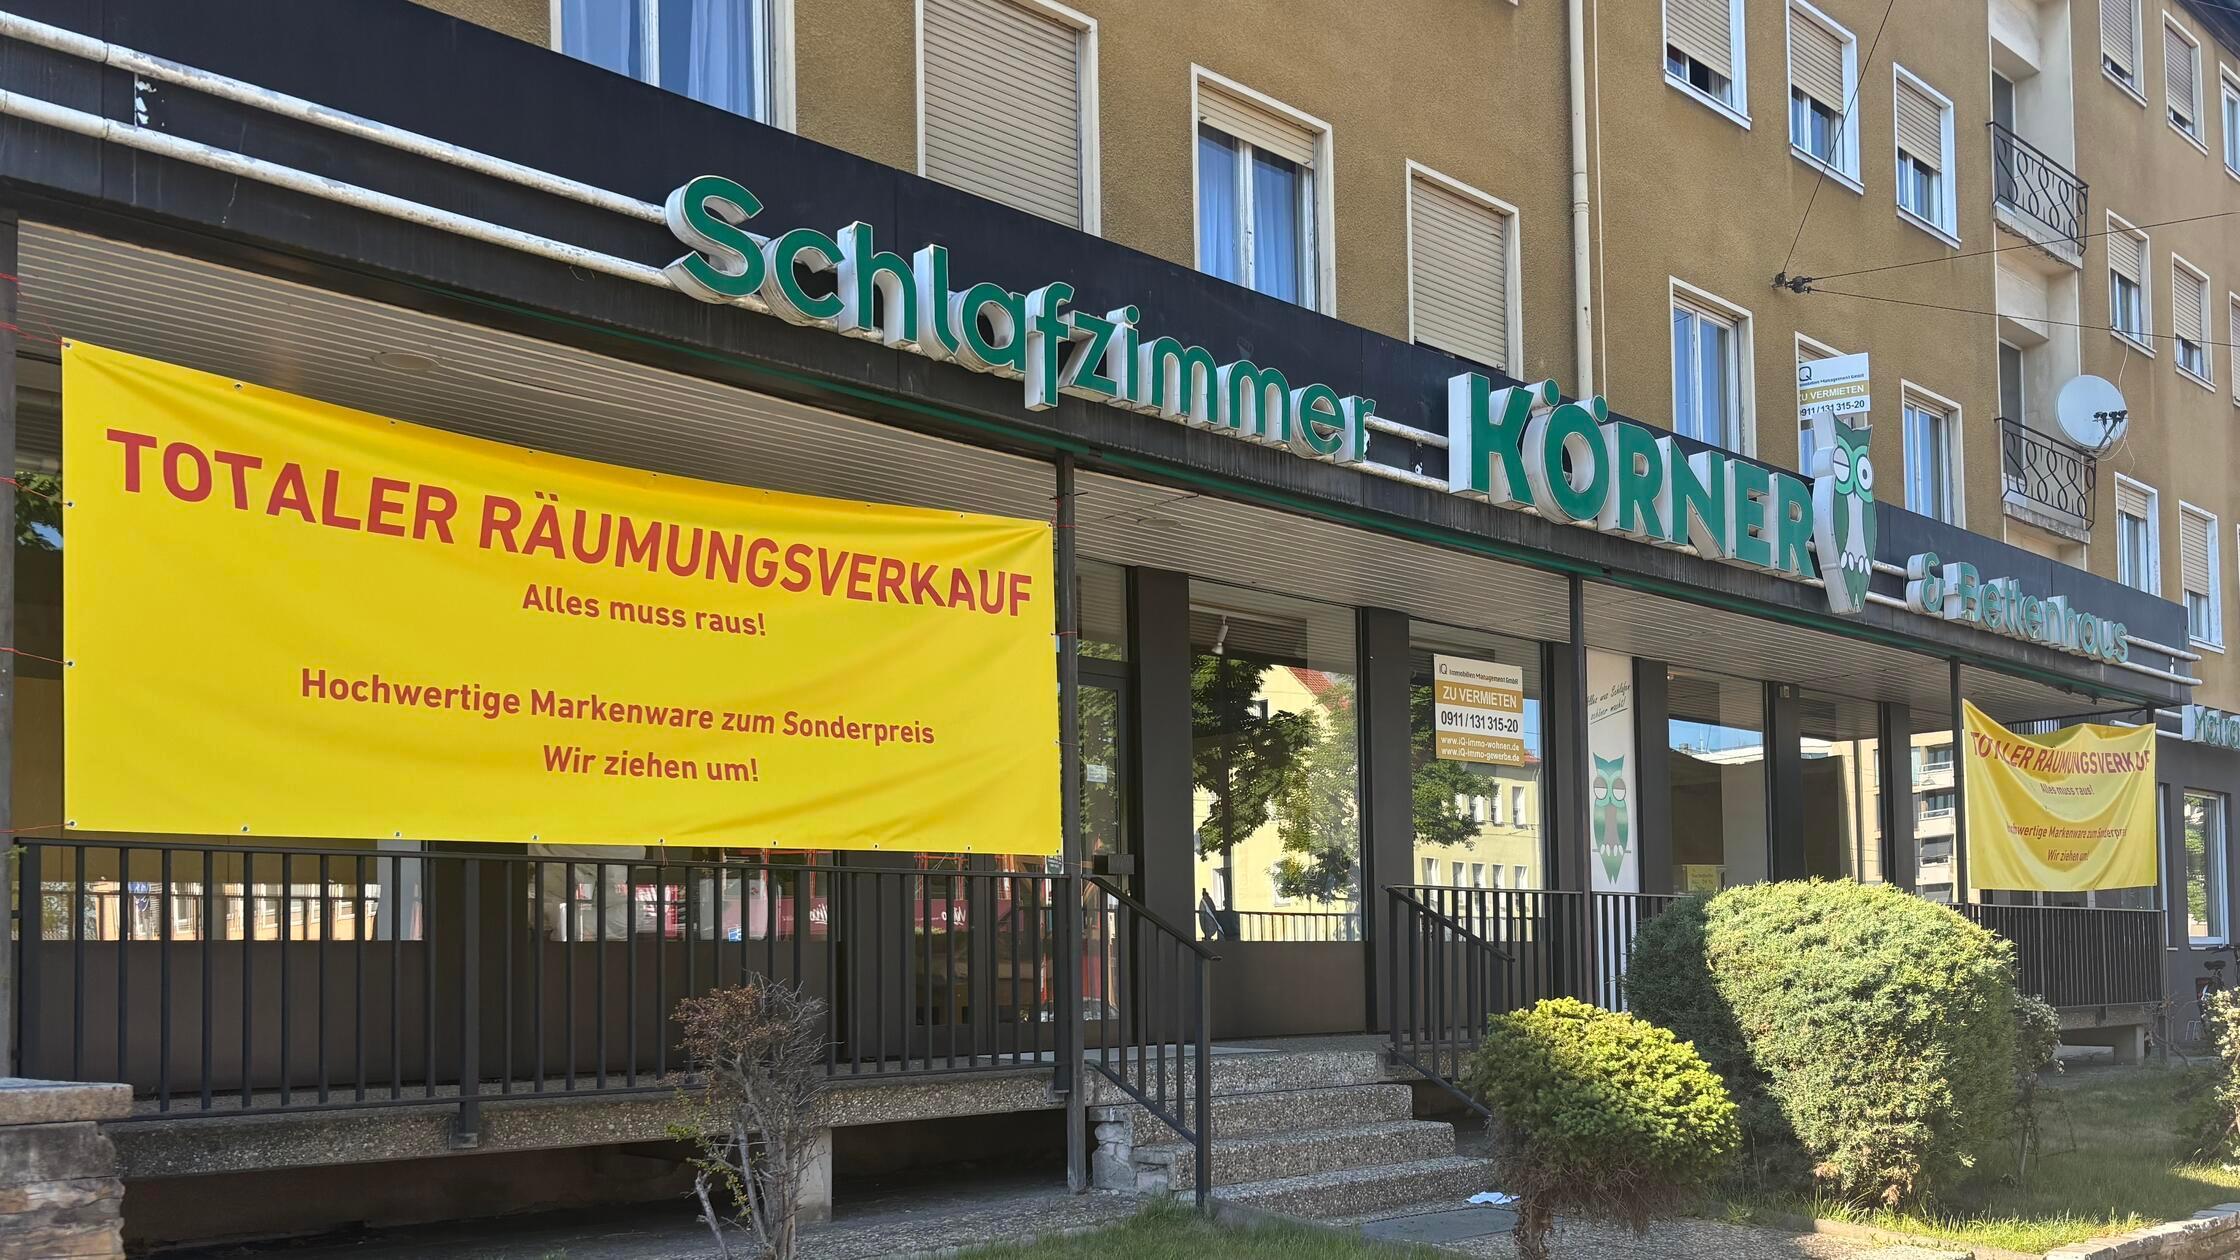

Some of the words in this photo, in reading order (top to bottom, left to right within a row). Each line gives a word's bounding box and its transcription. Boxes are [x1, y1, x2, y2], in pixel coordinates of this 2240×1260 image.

[666, 174, 1377, 464] Schlafzimmer
[1810, 385, 1865, 400] VERMIETEN
[1836, 400, 1865, 412] 315-20
[1448, 372, 1816, 577] KÖRNER
[106, 428, 458, 545] TOTALER
[478, 490, 1033, 617] RÄUMUNGSVERKAUF
[522, 584, 600, 618] Alles
[609, 600, 687, 630] muss
[695, 611, 766, 637] raus!
[1943, 561, 2129, 664] Bettenhaus
[1475, 673, 1505, 684] Management
[301, 668, 521, 719] Hochwertige
[530, 689, 714, 730] Markenware
[721, 713, 776, 735] zum
[782, 711, 936, 747] Sonderpreis
[1442, 686, 1457, 701] ZU
[1458, 687, 1517, 709] VERMIETEN
[1487, 716, 1519, 733] 315-20
[543, 745, 596, 775] Wir
[604, 749, 698, 780] ziehen
[706, 758, 760, 783] um!
[2048, 826, 2086, 839] Markenware
[2047, 849, 2059, 861] Wir
[2060, 850, 2080, 862] ziehen
